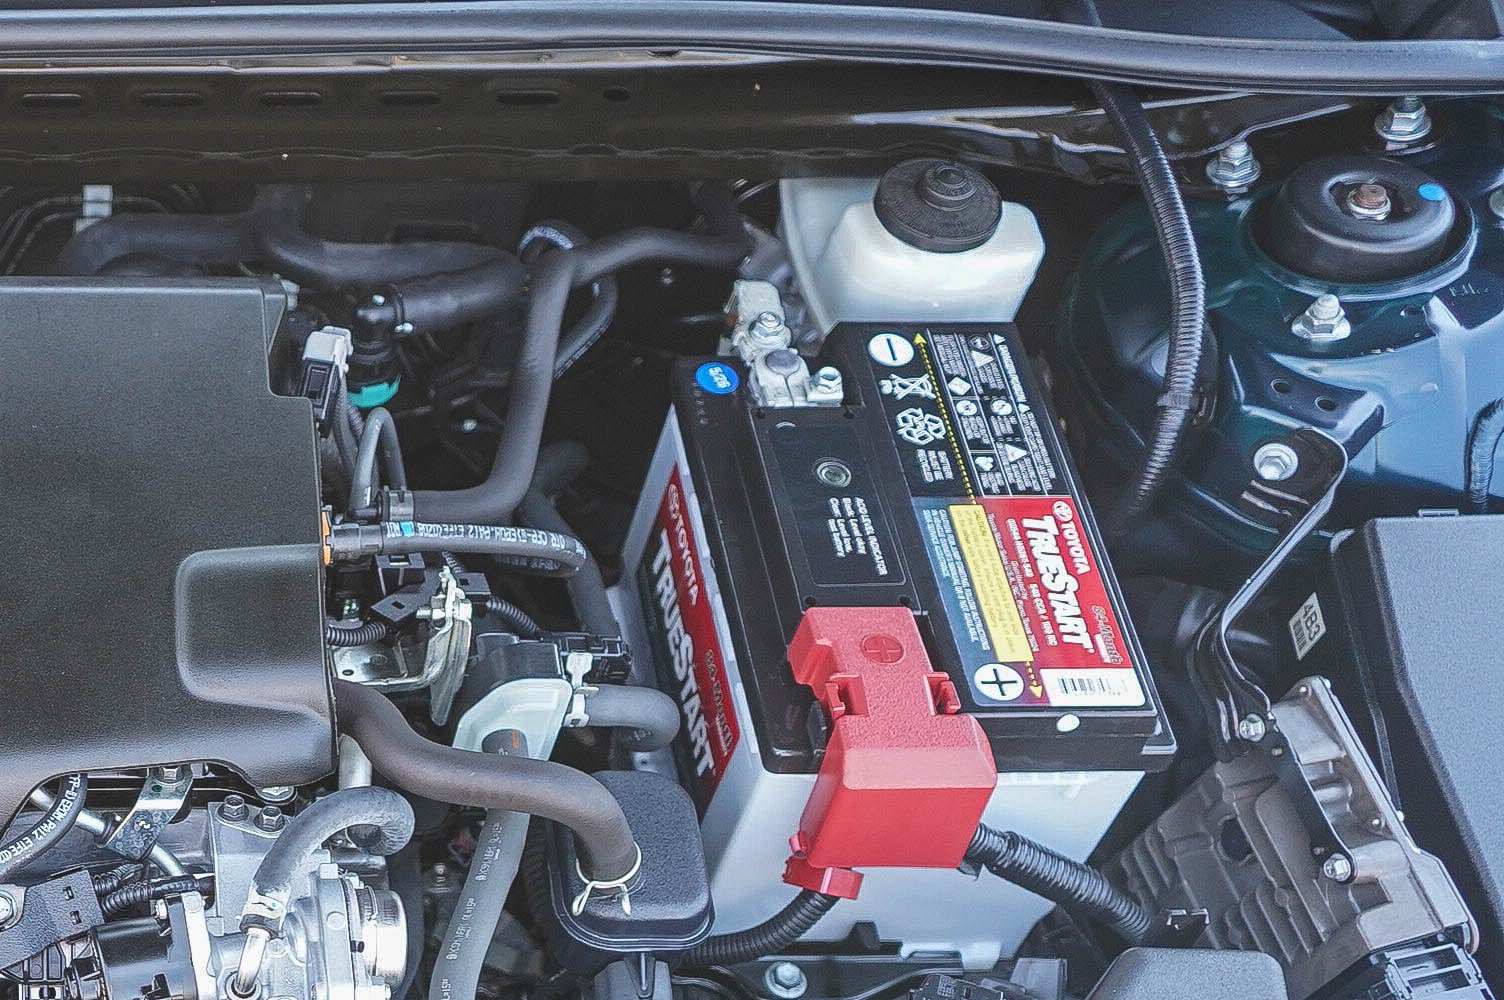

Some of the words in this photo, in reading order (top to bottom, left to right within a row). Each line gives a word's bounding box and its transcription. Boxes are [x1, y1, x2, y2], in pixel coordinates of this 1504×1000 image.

[673, 510, 700, 610] TOYOTA
[1059, 523, 1091, 575] TOYOTA
[1303, 603, 1320, 641] 4B3
